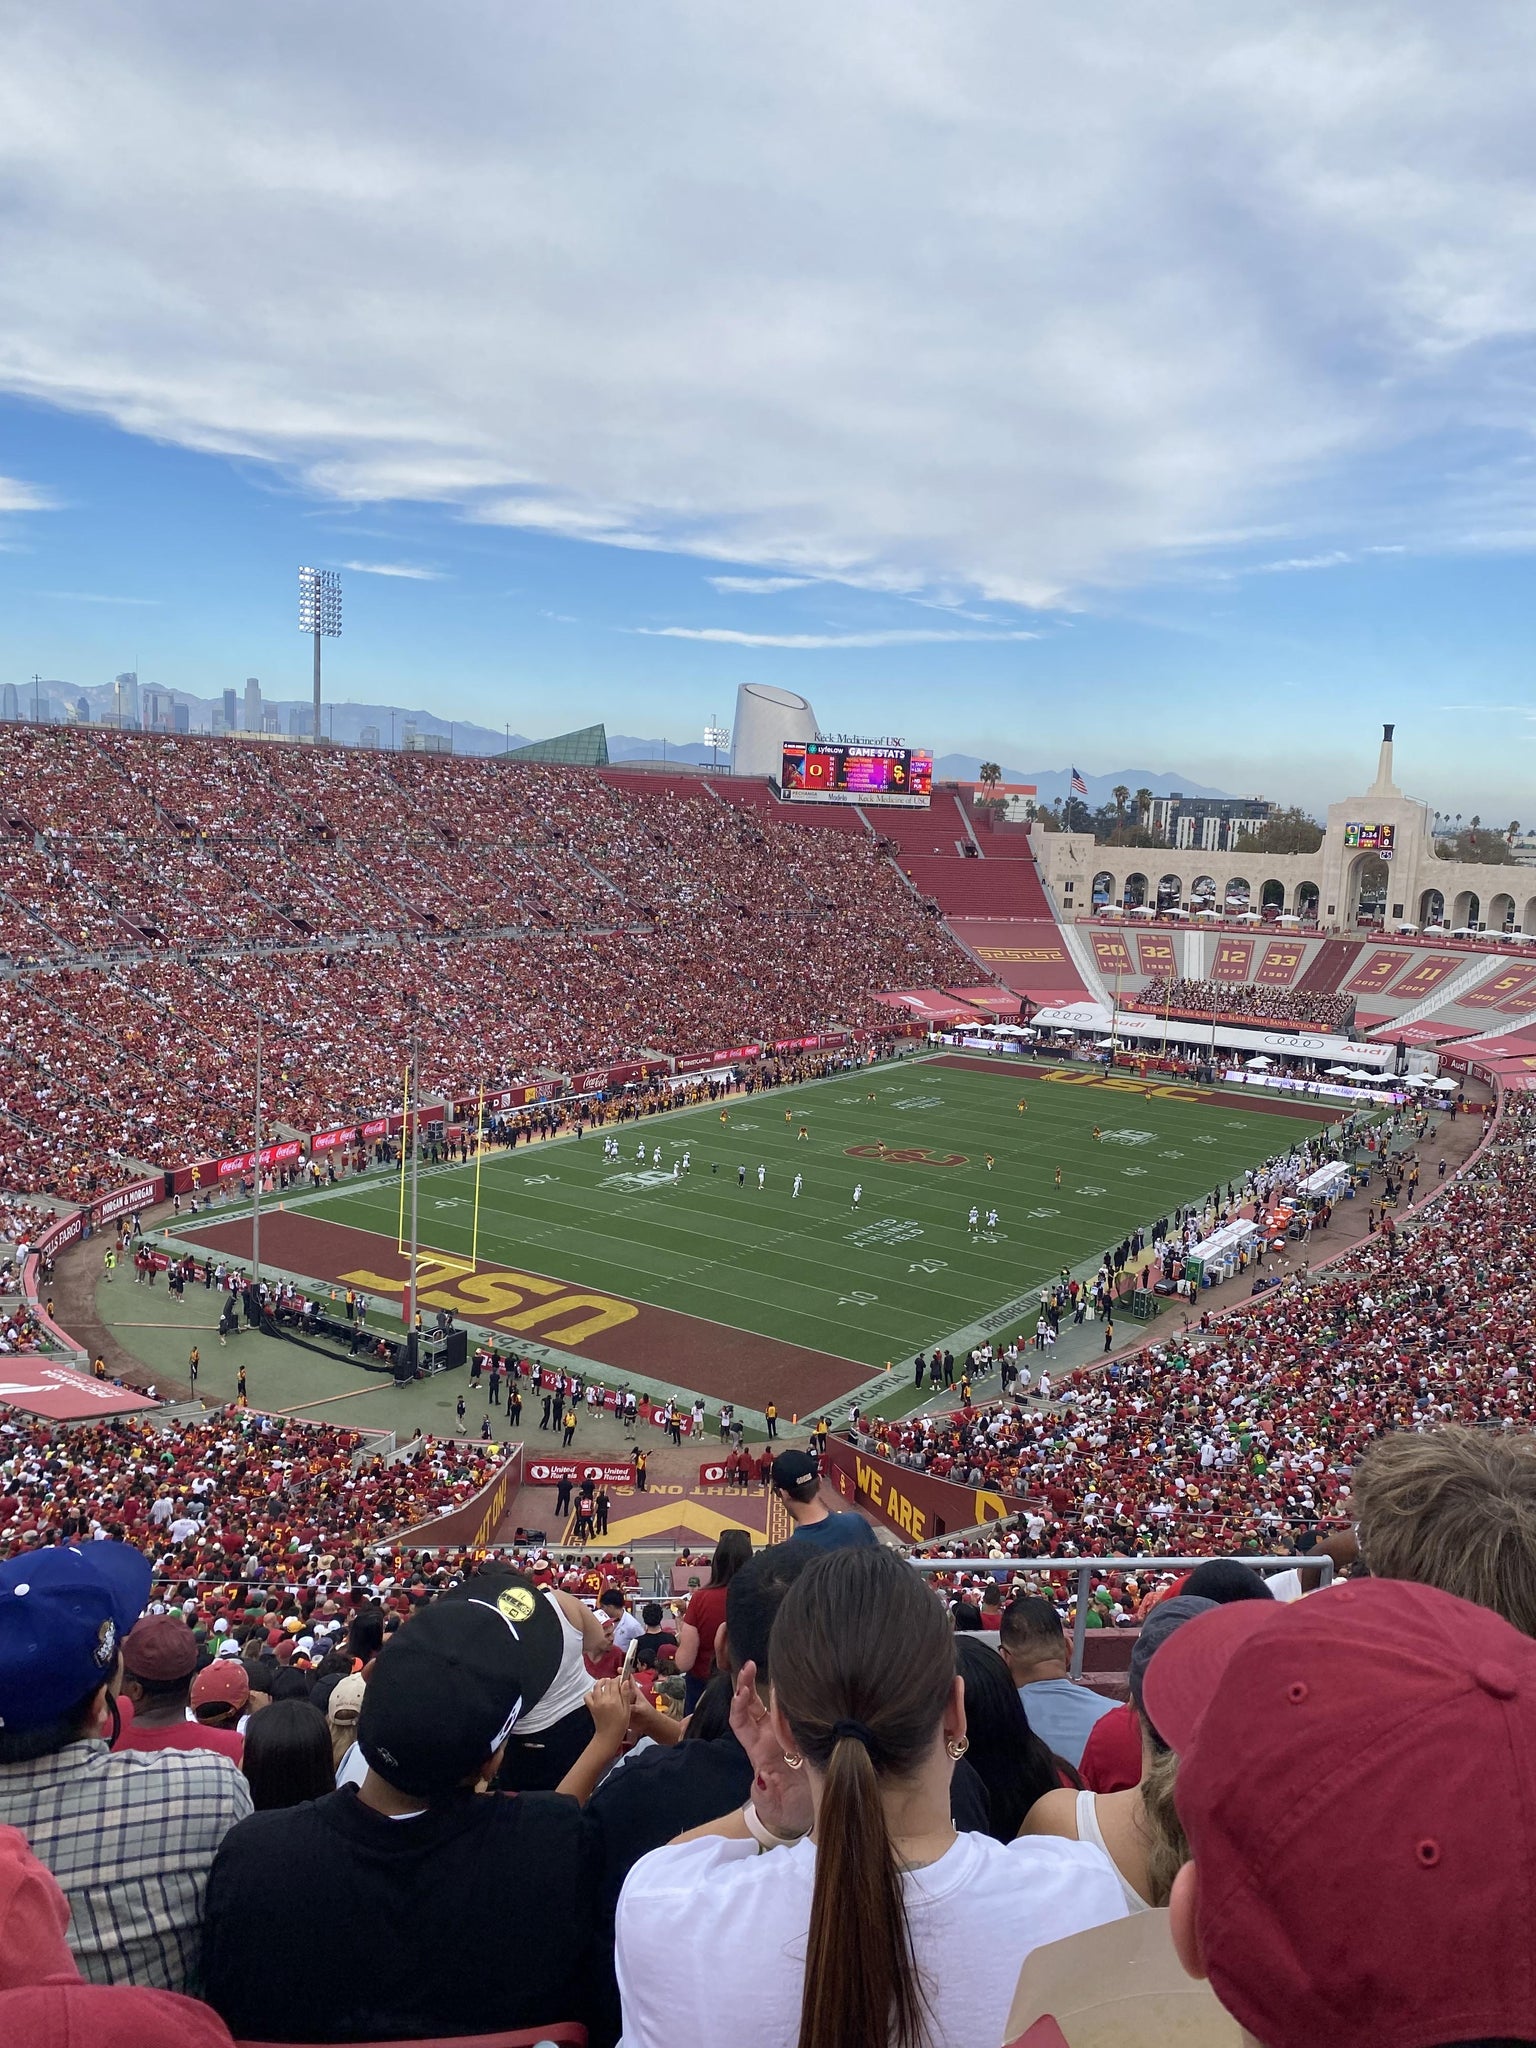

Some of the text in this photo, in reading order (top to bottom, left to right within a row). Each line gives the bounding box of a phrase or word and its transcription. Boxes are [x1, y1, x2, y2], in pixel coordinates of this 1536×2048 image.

[814, 732, 906, 747] Keck Medicine of USC
[848, 747, 906, 759] GAME STATS
[914, 797, 929, 806] USC
[1096, 943, 1126, 957] 20
[1141, 945, 1172, 959] 32
[1219, 950, 1247, 963] 12
[1265, 953, 1298, 968] 33
[1371, 963, 1393, 976] 3
[1414, 967, 1443, 982] 11
[1354, 979, 1382, 988] 2002
[1494, 976, 1522, 990] 5
[1106, 1018, 1147, 1029] Audi
[1341, 1045, 1388, 1056] Audi
[1451, 1059, 1468, 1072] Audi
[583, 1072, 609, 1090] Coca-Cola
[1040, 1070, 1214, 1102] USC
[364, 1121, 385, 1136] Coca-Cola
[315, 1133, 337, 1149] Coca-Cola
[275, 1142, 298, 1158] Coca-Cola
[220, 1157, 244, 1172] Coca-Cola
[102, 1184, 154, 1217] MORGAN & MORGAN
[59, 1219, 82, 1246] FARGO
[842, 1218, 898, 1241] UNITED
[852, 1219, 919, 1248] AIRLINES
[883, 1228, 925, 1246] FIELD
[909, 1257, 949, 1274] 20
[336, 1250, 640, 1346] USC
[839, 1290, 879, 1307] 10
[550, 1472, 578, 1480] Renals
[551, 1465, 577, 1473] United
[604, 1466, 630, 1475] United
[603, 1473, 631, 1481] Rentals
[649, 1484, 684, 1496] ON
[689, 1485, 766, 1498] FIGHT
[856, 1455, 883, 1507] WE
[886, 1486, 926, 1544] ARE
[475, 1549, 486, 1561] 14
